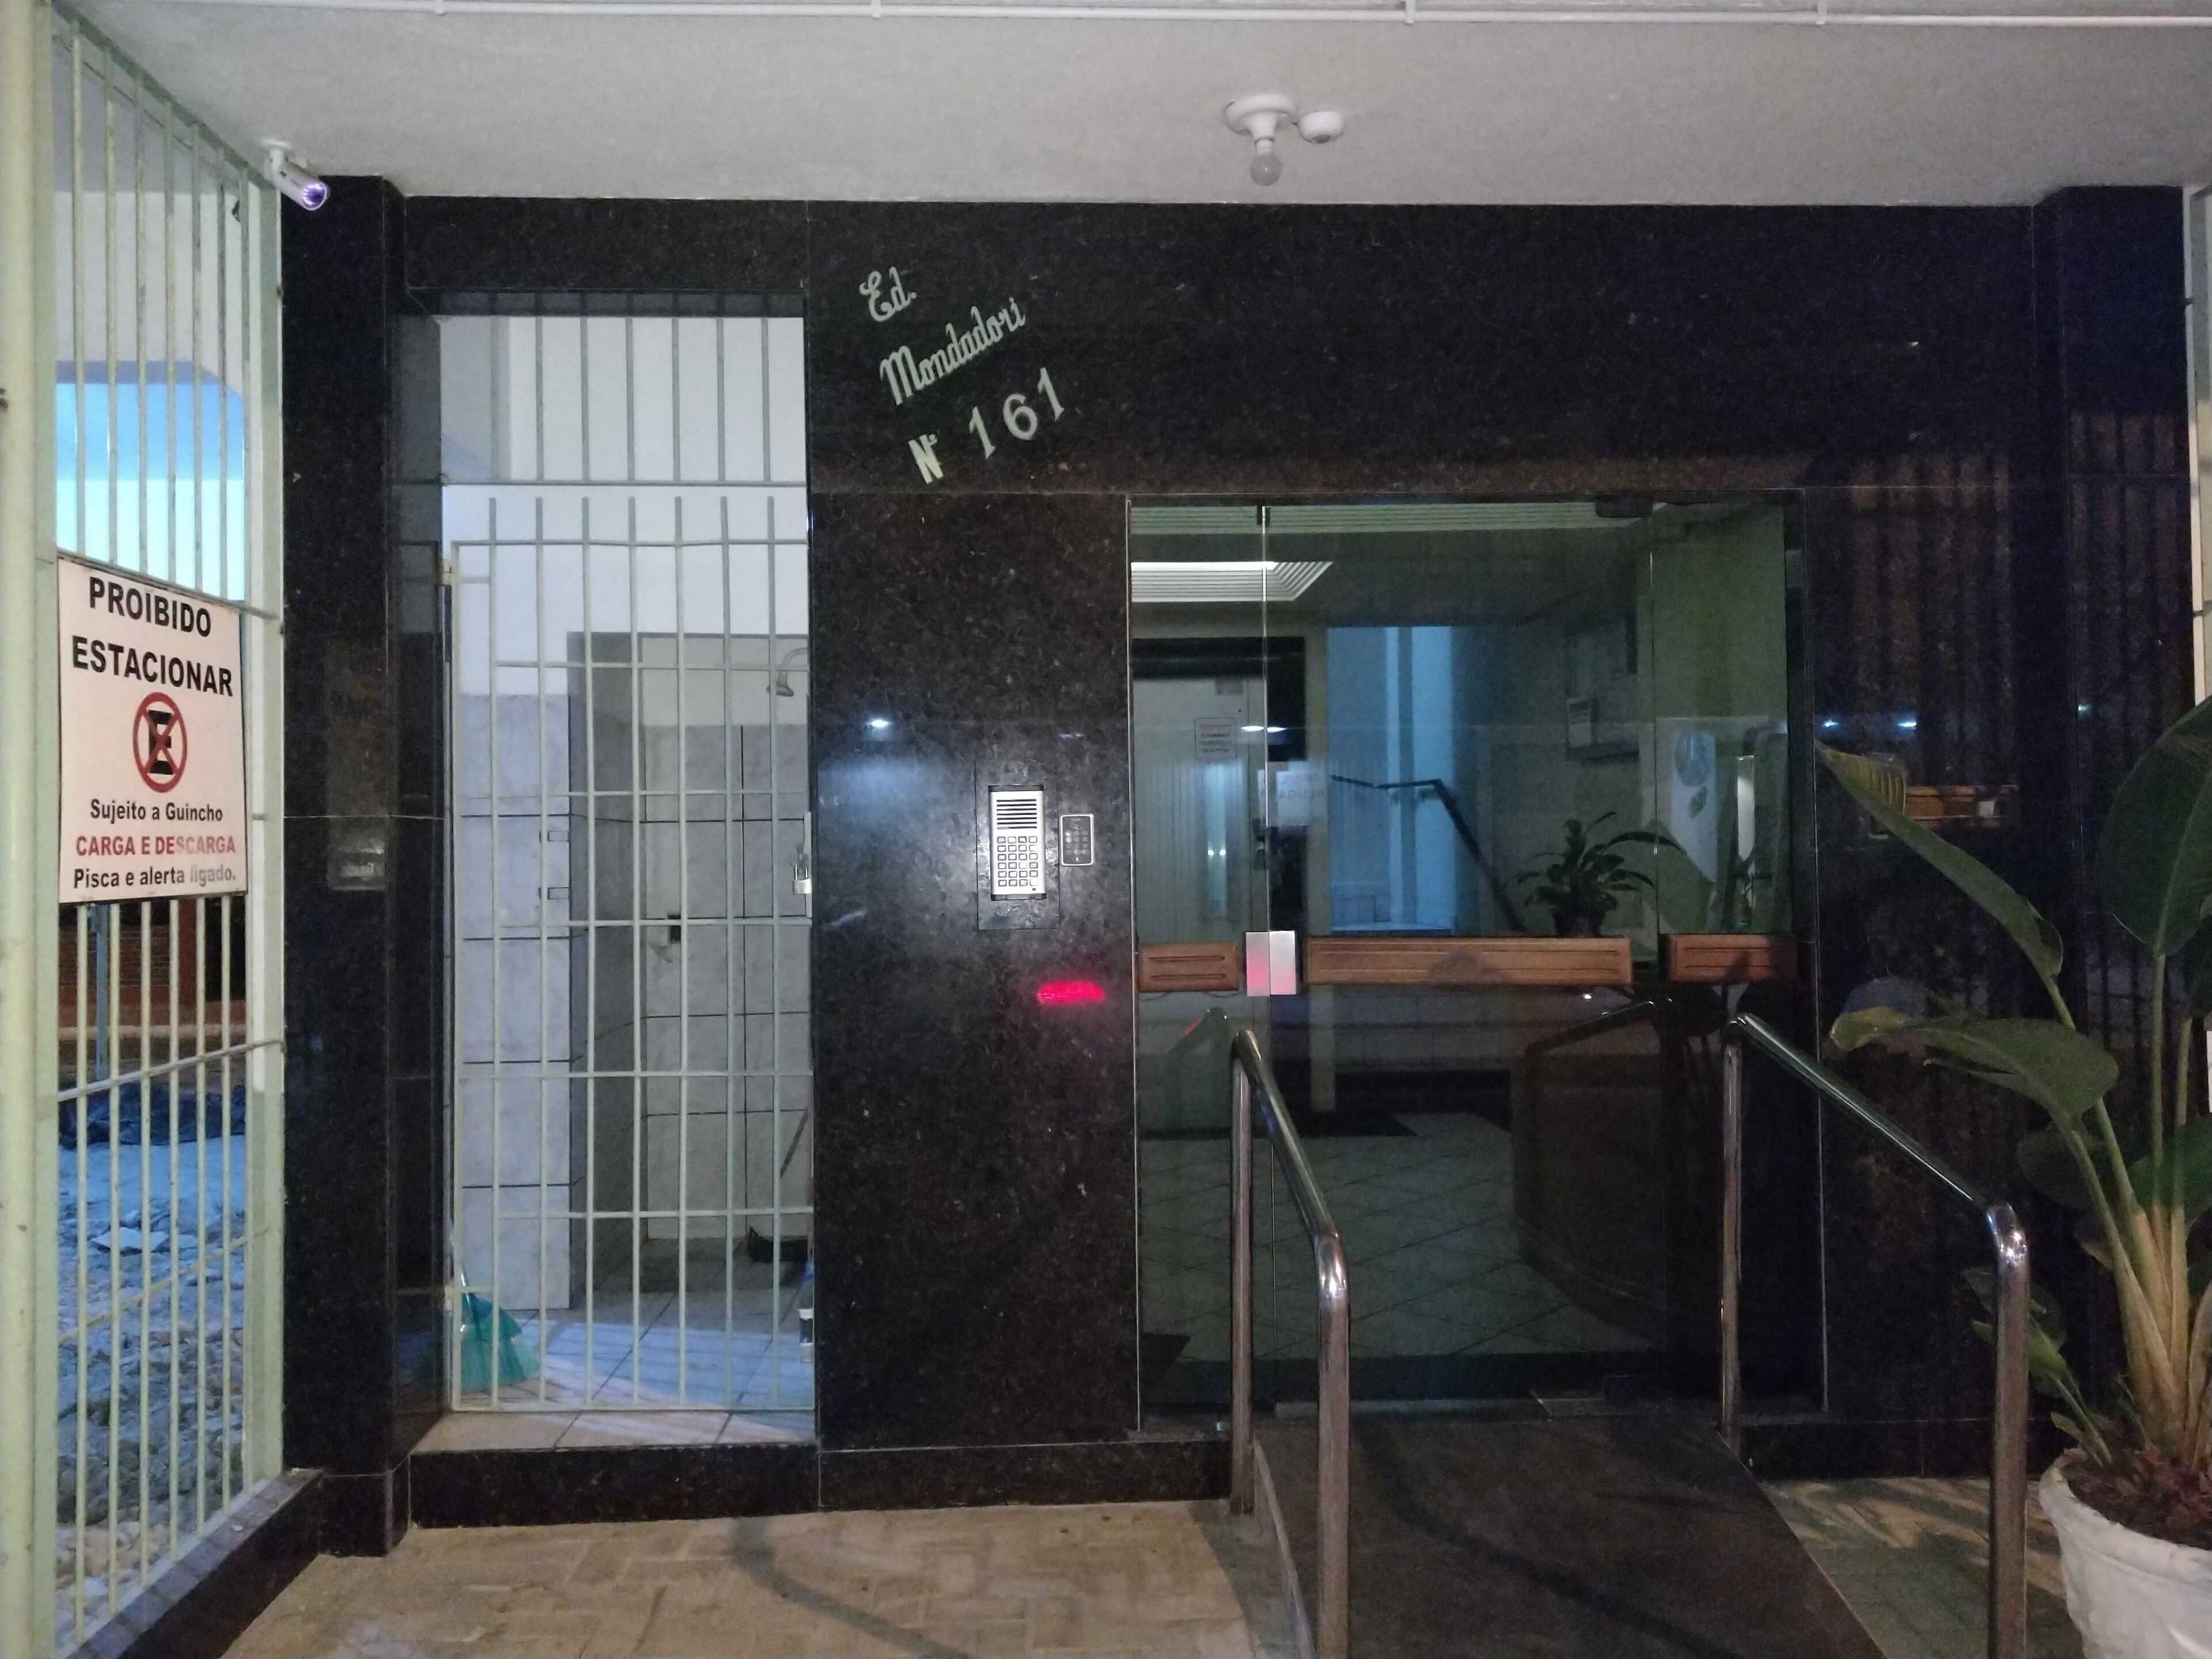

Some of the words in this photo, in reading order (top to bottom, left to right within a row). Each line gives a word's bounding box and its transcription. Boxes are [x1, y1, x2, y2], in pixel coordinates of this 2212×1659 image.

[880, 297, 1026, 406] Mondadori
[969, 367, 1065, 459] 161
[89, 576, 211, 638] PROIBIDO
[72, 635, 233, 697] ESTACIONAR
[90, 798, 146, 824] Sujeito
[152, 806, 160, 820] a
[165, 802, 223, 821] Guincho
[74, 868, 120, 889] Pisca
[125, 870, 135, 886] e
[139, 866, 185, 885] alerta
[75, 836, 136, 857] CARGA
[141, 836, 150, 855] E
[155, 836, 236, 855] DESCARGA
